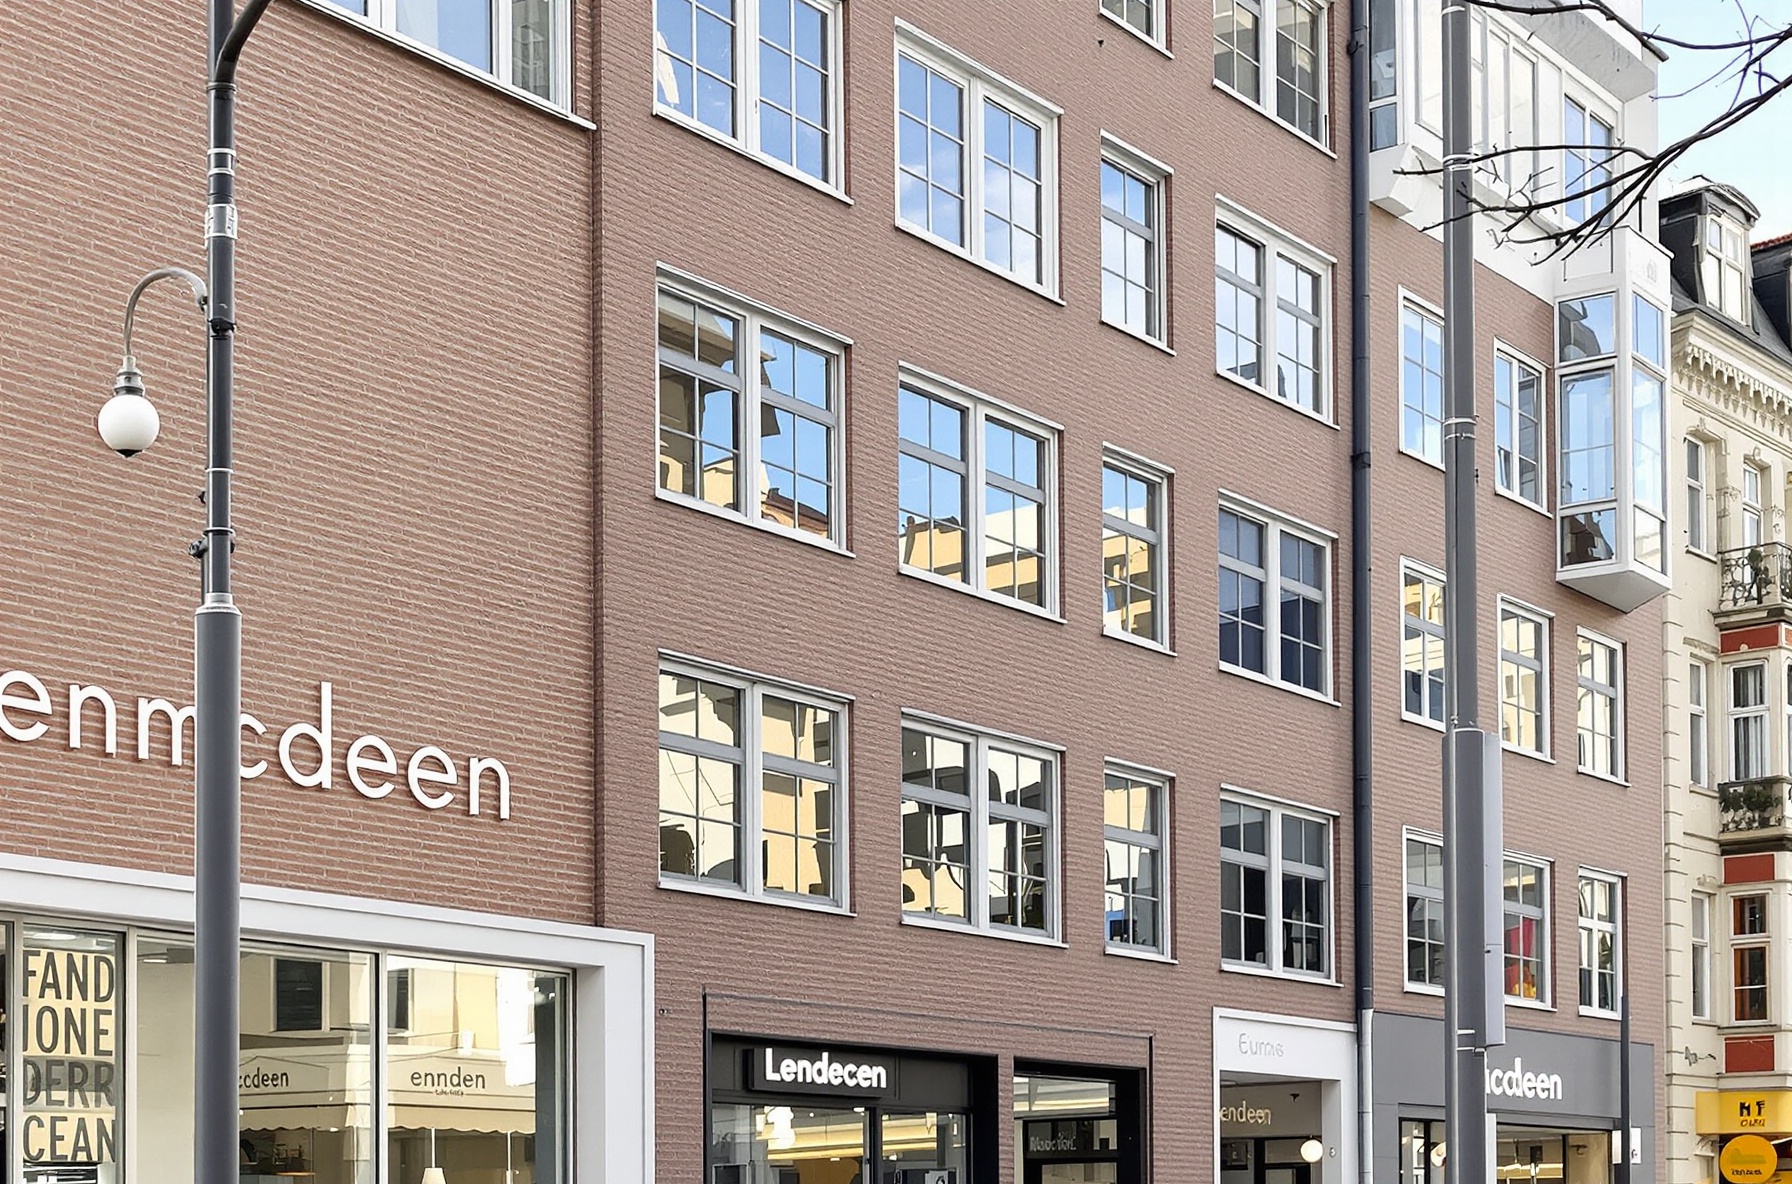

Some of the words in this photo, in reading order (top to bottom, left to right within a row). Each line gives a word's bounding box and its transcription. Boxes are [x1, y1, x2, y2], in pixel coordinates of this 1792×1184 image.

[23, 950, 115, 1003] FAND
[410, 1066, 486, 1089] ennden
[765, 1048, 887, 1088] Lendecen
[23, 1115, 116, 1163] CEAN
